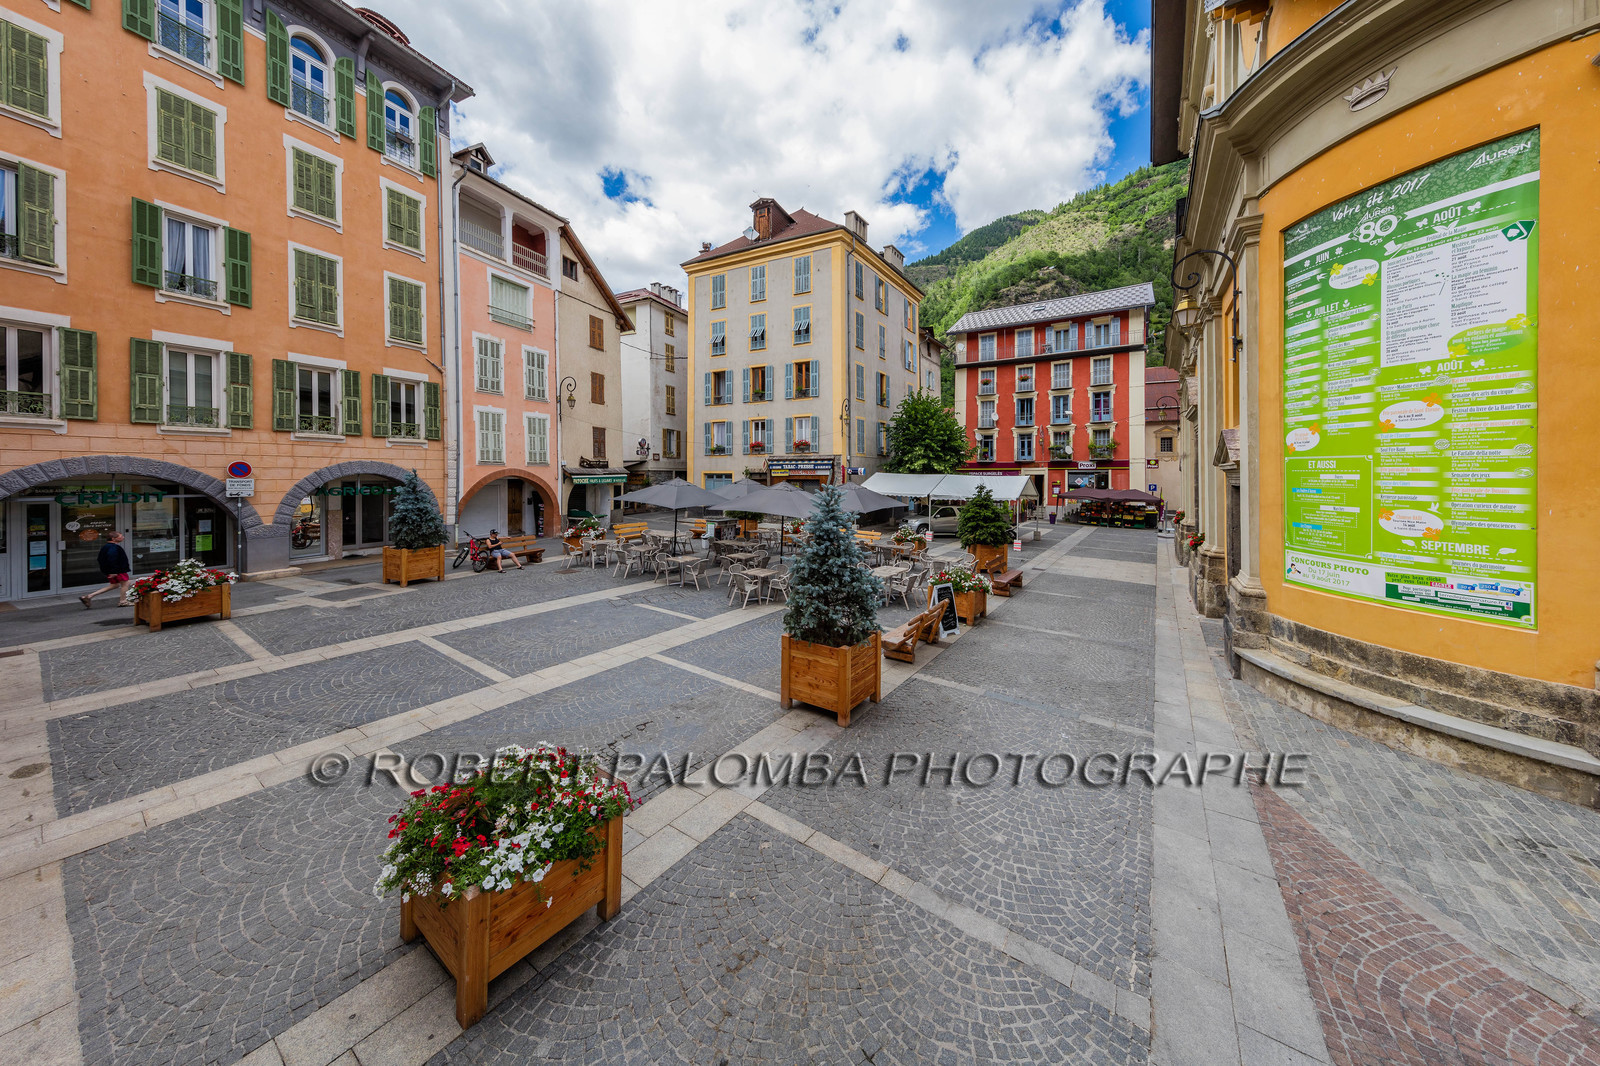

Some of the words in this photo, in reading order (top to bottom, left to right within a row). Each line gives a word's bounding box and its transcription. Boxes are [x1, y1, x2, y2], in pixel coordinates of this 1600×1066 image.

[1332, 204, 1360, 222] Votre
[1366, 191, 1384, 208] été
[1390, 173, 1431, 200] 2017
[1433, 206, 1462, 224] AOÛT
[1359, 215, 1398, 243] 80
[1316, 251, 1329, 264] JUIN
[1314, 302, 1339, 316] JUILLET
[1437, 360, 1464, 372] AOÛT
[1421, 540, 1490, 555] SEPTEMBRE
[1290, 556, 1331, 569] CONCOURS
[1333, 563, 1368, 575] PHOTO
[1332, 577, 1349, 586] 2017
